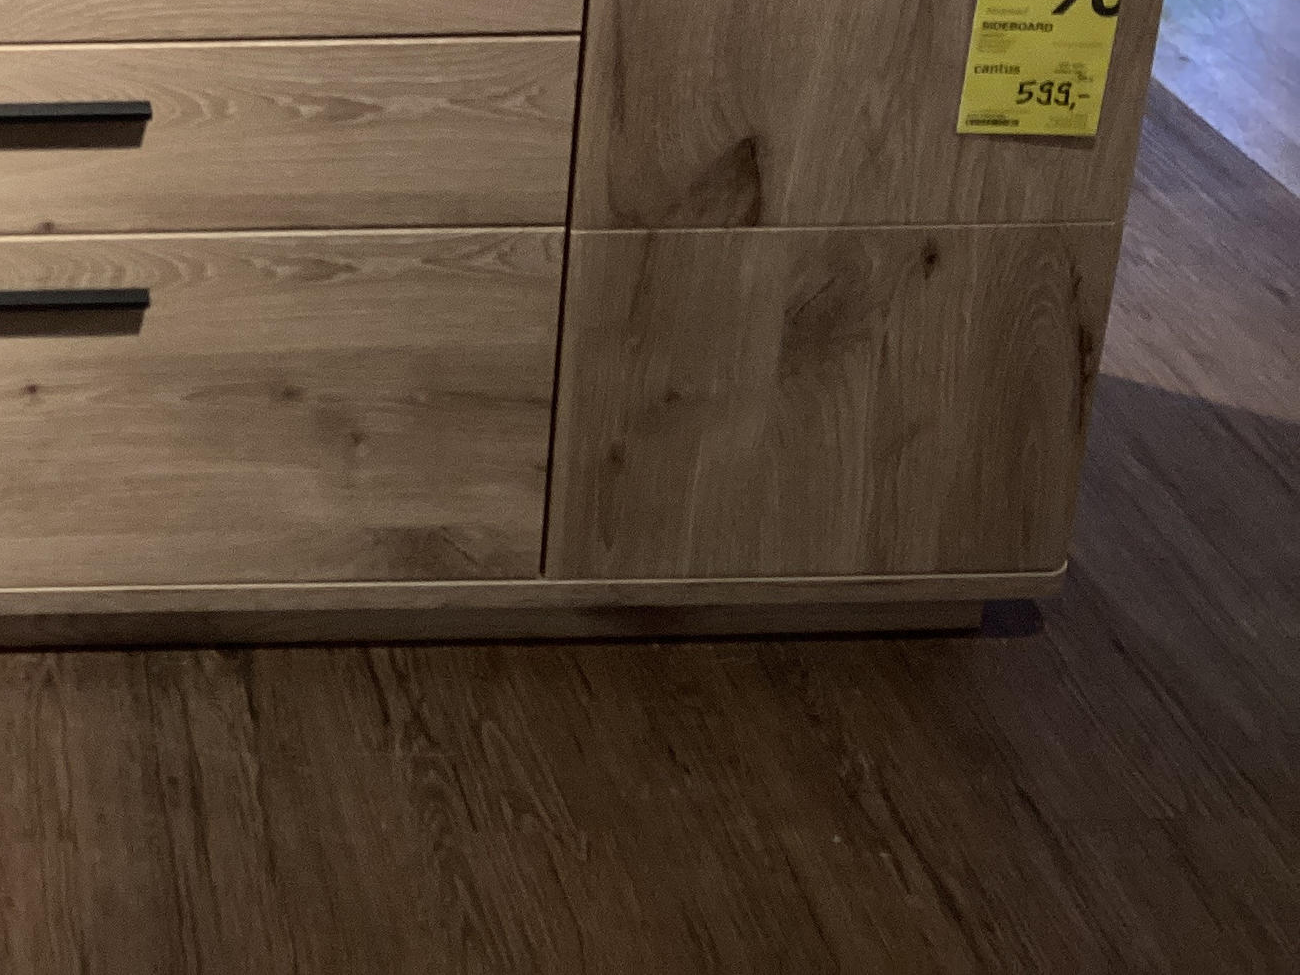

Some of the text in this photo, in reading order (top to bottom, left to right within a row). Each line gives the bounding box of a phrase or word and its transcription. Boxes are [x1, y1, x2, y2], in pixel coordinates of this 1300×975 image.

[982, 20, 1054, 33] SIDEBOARD
[973, 63, 1021, 75] cantus
[1015, 78, 1091, 111] 599,-
